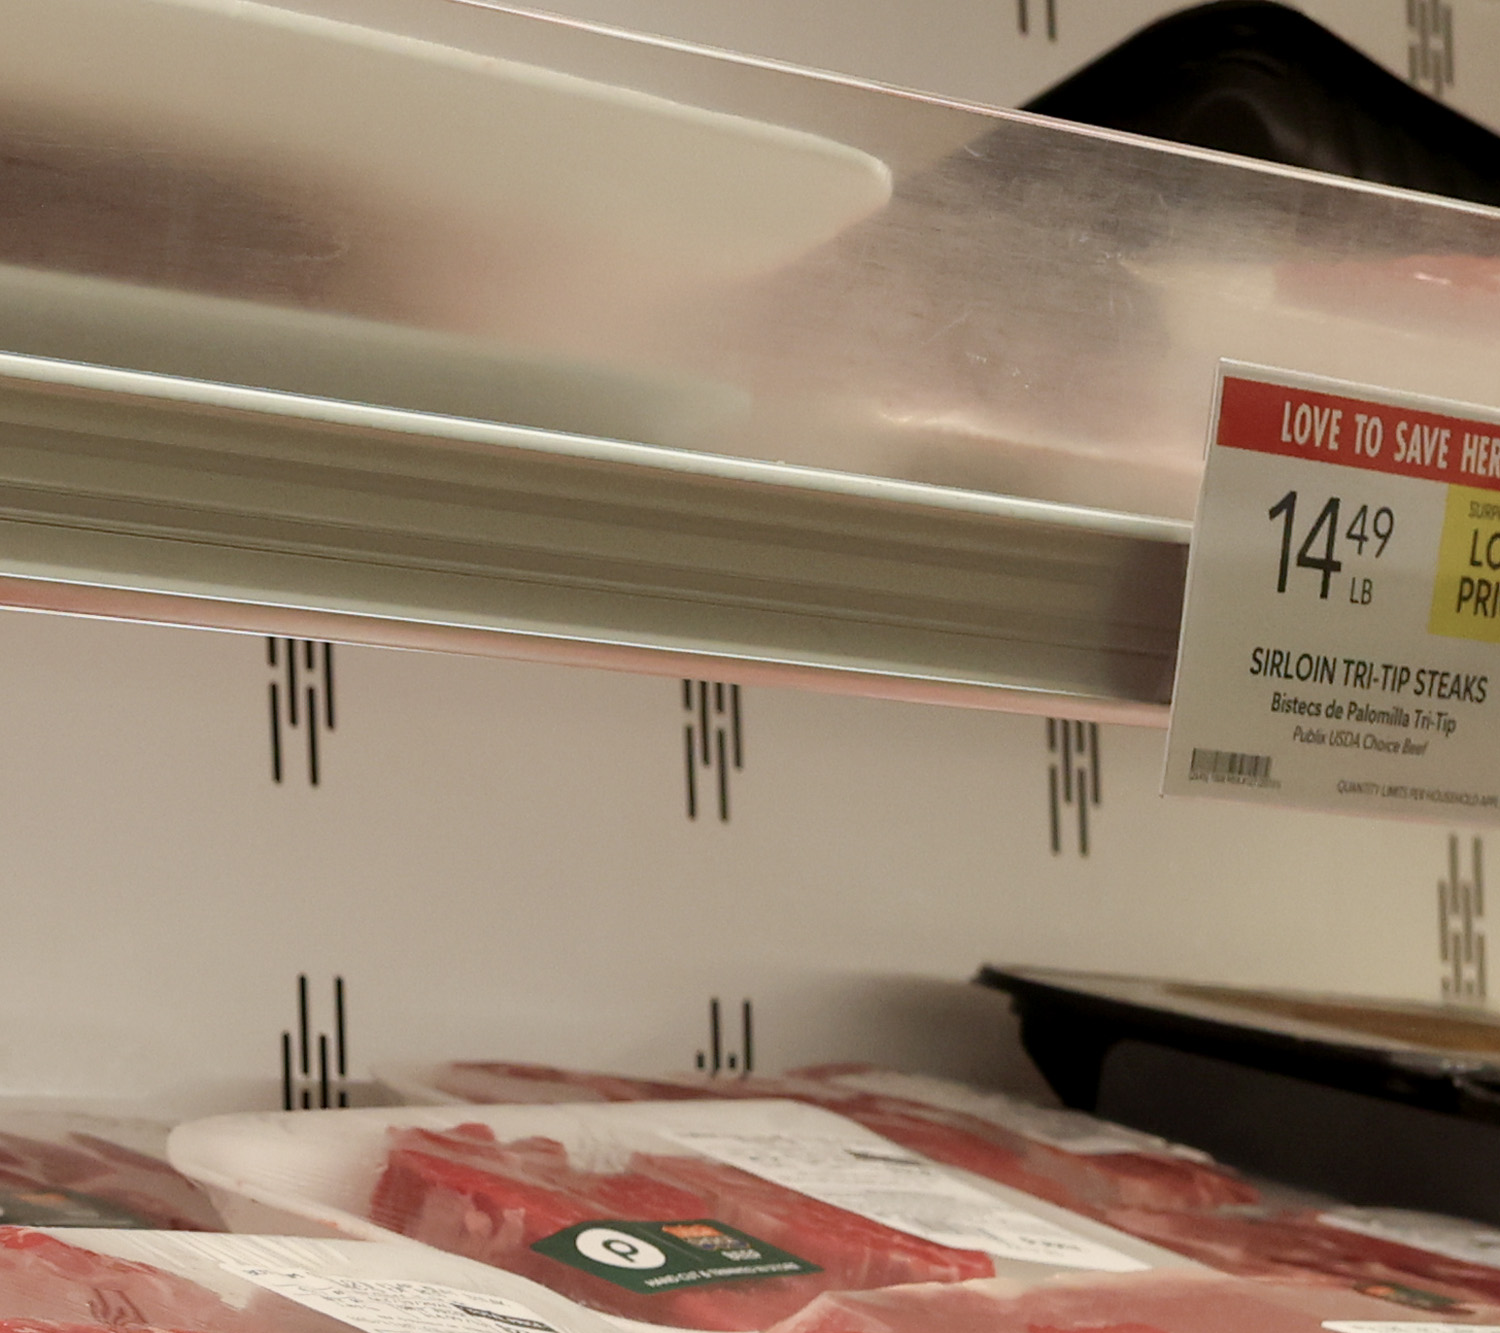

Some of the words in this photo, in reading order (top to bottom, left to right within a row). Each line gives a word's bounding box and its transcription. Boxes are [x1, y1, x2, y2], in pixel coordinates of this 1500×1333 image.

[1281, 401, 1343, 451] LOVE
[1355, 414, 1383, 458] TO
[1394, 421, 1451, 469] SAVE
[1350, 576, 1373, 605] LB
[1249, 646, 1337, 686] SIRLOIN
[1342, 658, 1411, 694] TRI-TIP
[1414, 668, 1488, 704] STEAKS
[1271, 691, 1322, 718] Bistecs
[1325, 698, 1343, 720] de
[1346, 702, 1410, 729] Palomilla
[1414, 709, 1457, 736] Tri-Tip
[1293, 726, 1326, 745] Publix
[1329, 730, 1361, 750] USDA
[1363, 735, 1400, 754] Choice
